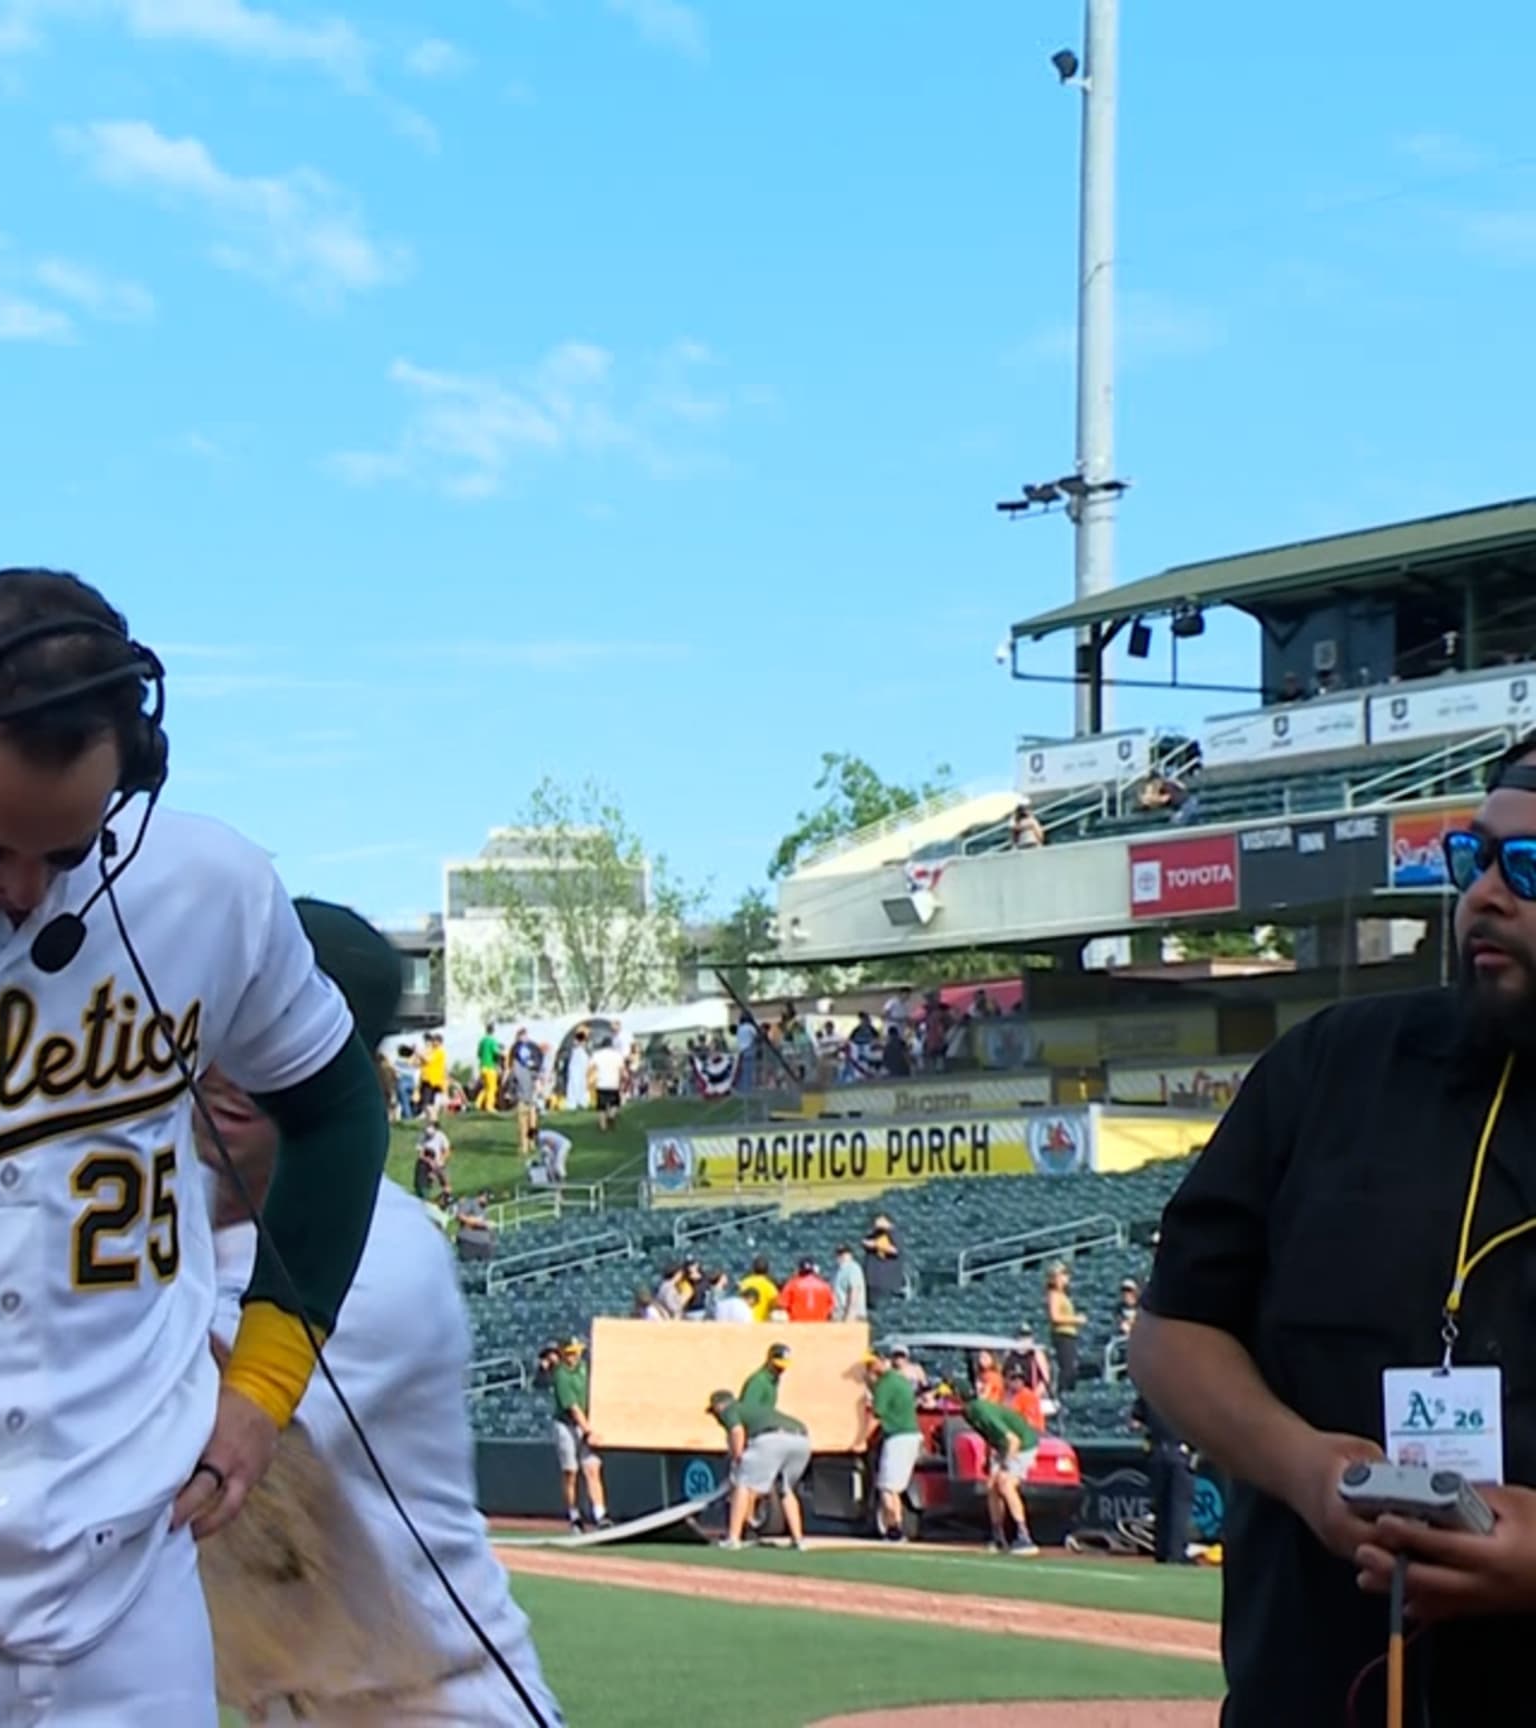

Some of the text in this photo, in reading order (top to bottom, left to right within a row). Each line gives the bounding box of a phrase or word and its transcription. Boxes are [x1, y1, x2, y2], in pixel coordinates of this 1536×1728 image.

[1242, 816, 1379, 852] VISITOR INN HOME
[1166, 864, 1232, 888] TOYOTA
[737, 1124, 991, 1182] PACIFICO PORCH
[70, 1145, 180, 1291] 25
[1453, 1408, 1485, 1428] 26
